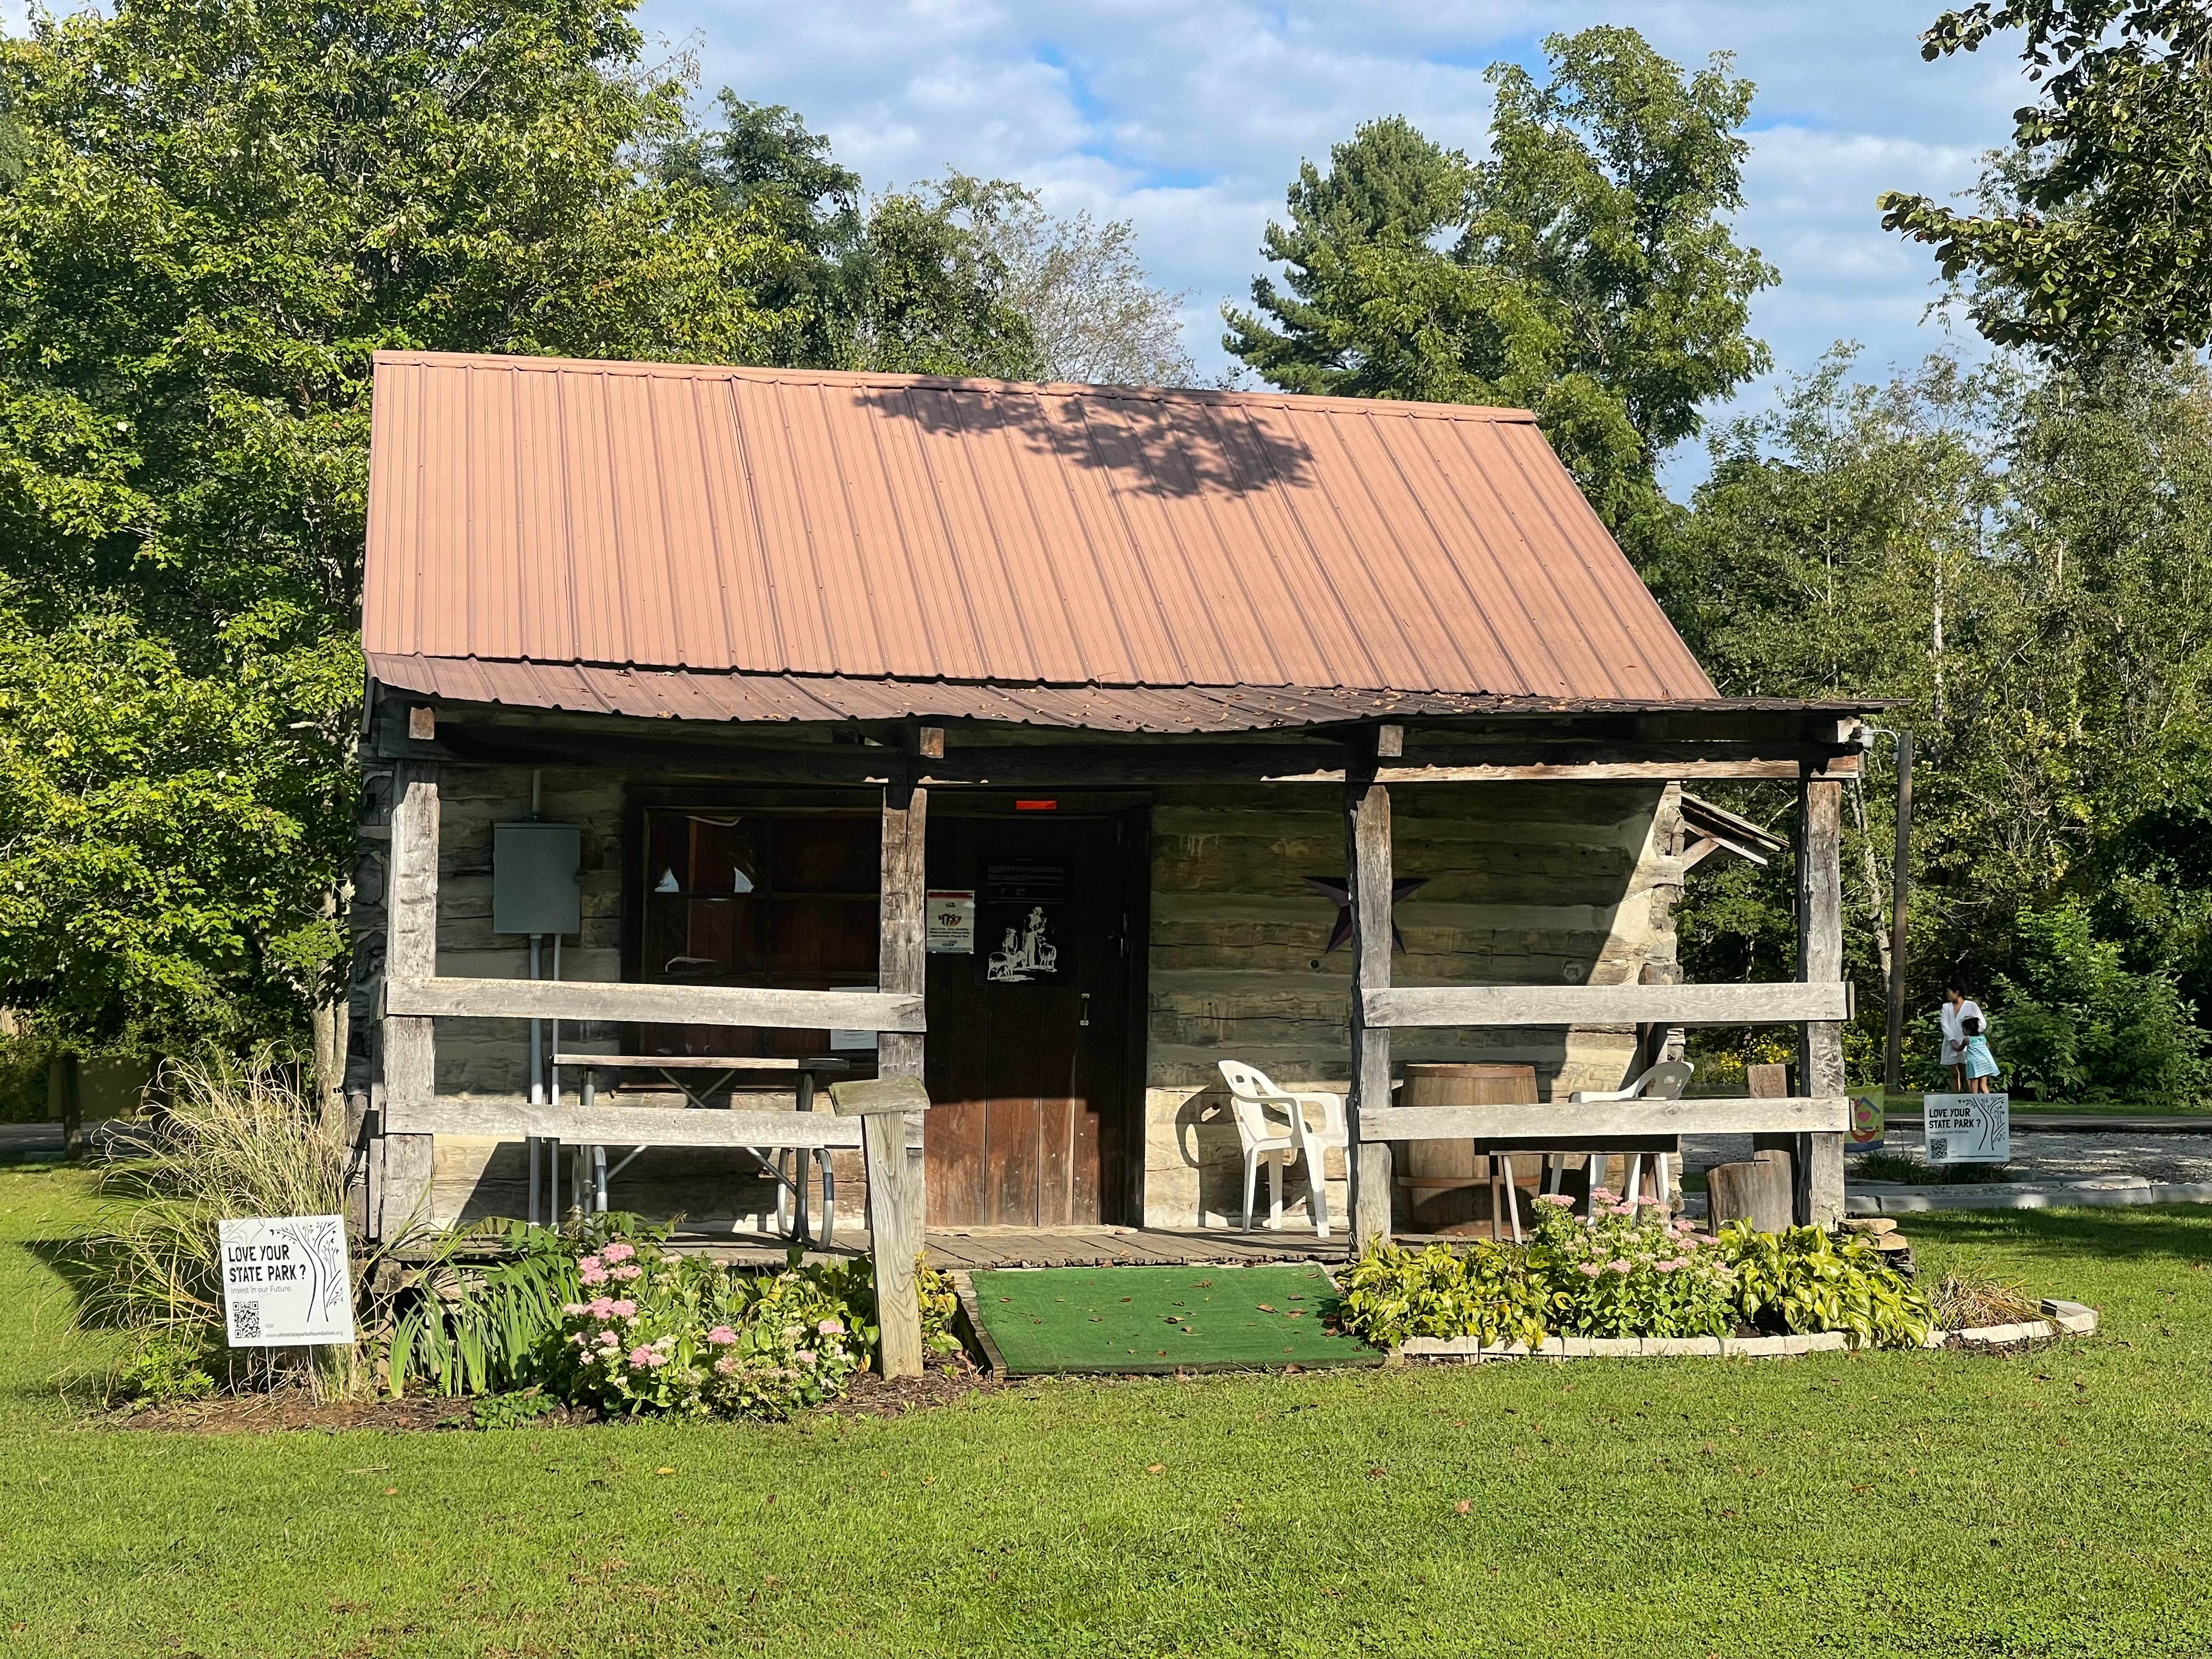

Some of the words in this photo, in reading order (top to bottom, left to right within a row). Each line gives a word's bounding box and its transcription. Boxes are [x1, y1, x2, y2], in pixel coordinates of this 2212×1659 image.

[1929, 1109, 1948, 1118] LOVE
[1950, 1108, 1971, 1117] YOUR
[1929, 1120, 1951, 1128] STATE
[228, 1246, 256, 1262] LOVE
[260, 1244, 290, 1261] YOUR
[229, 1266, 263, 1283] STATE
